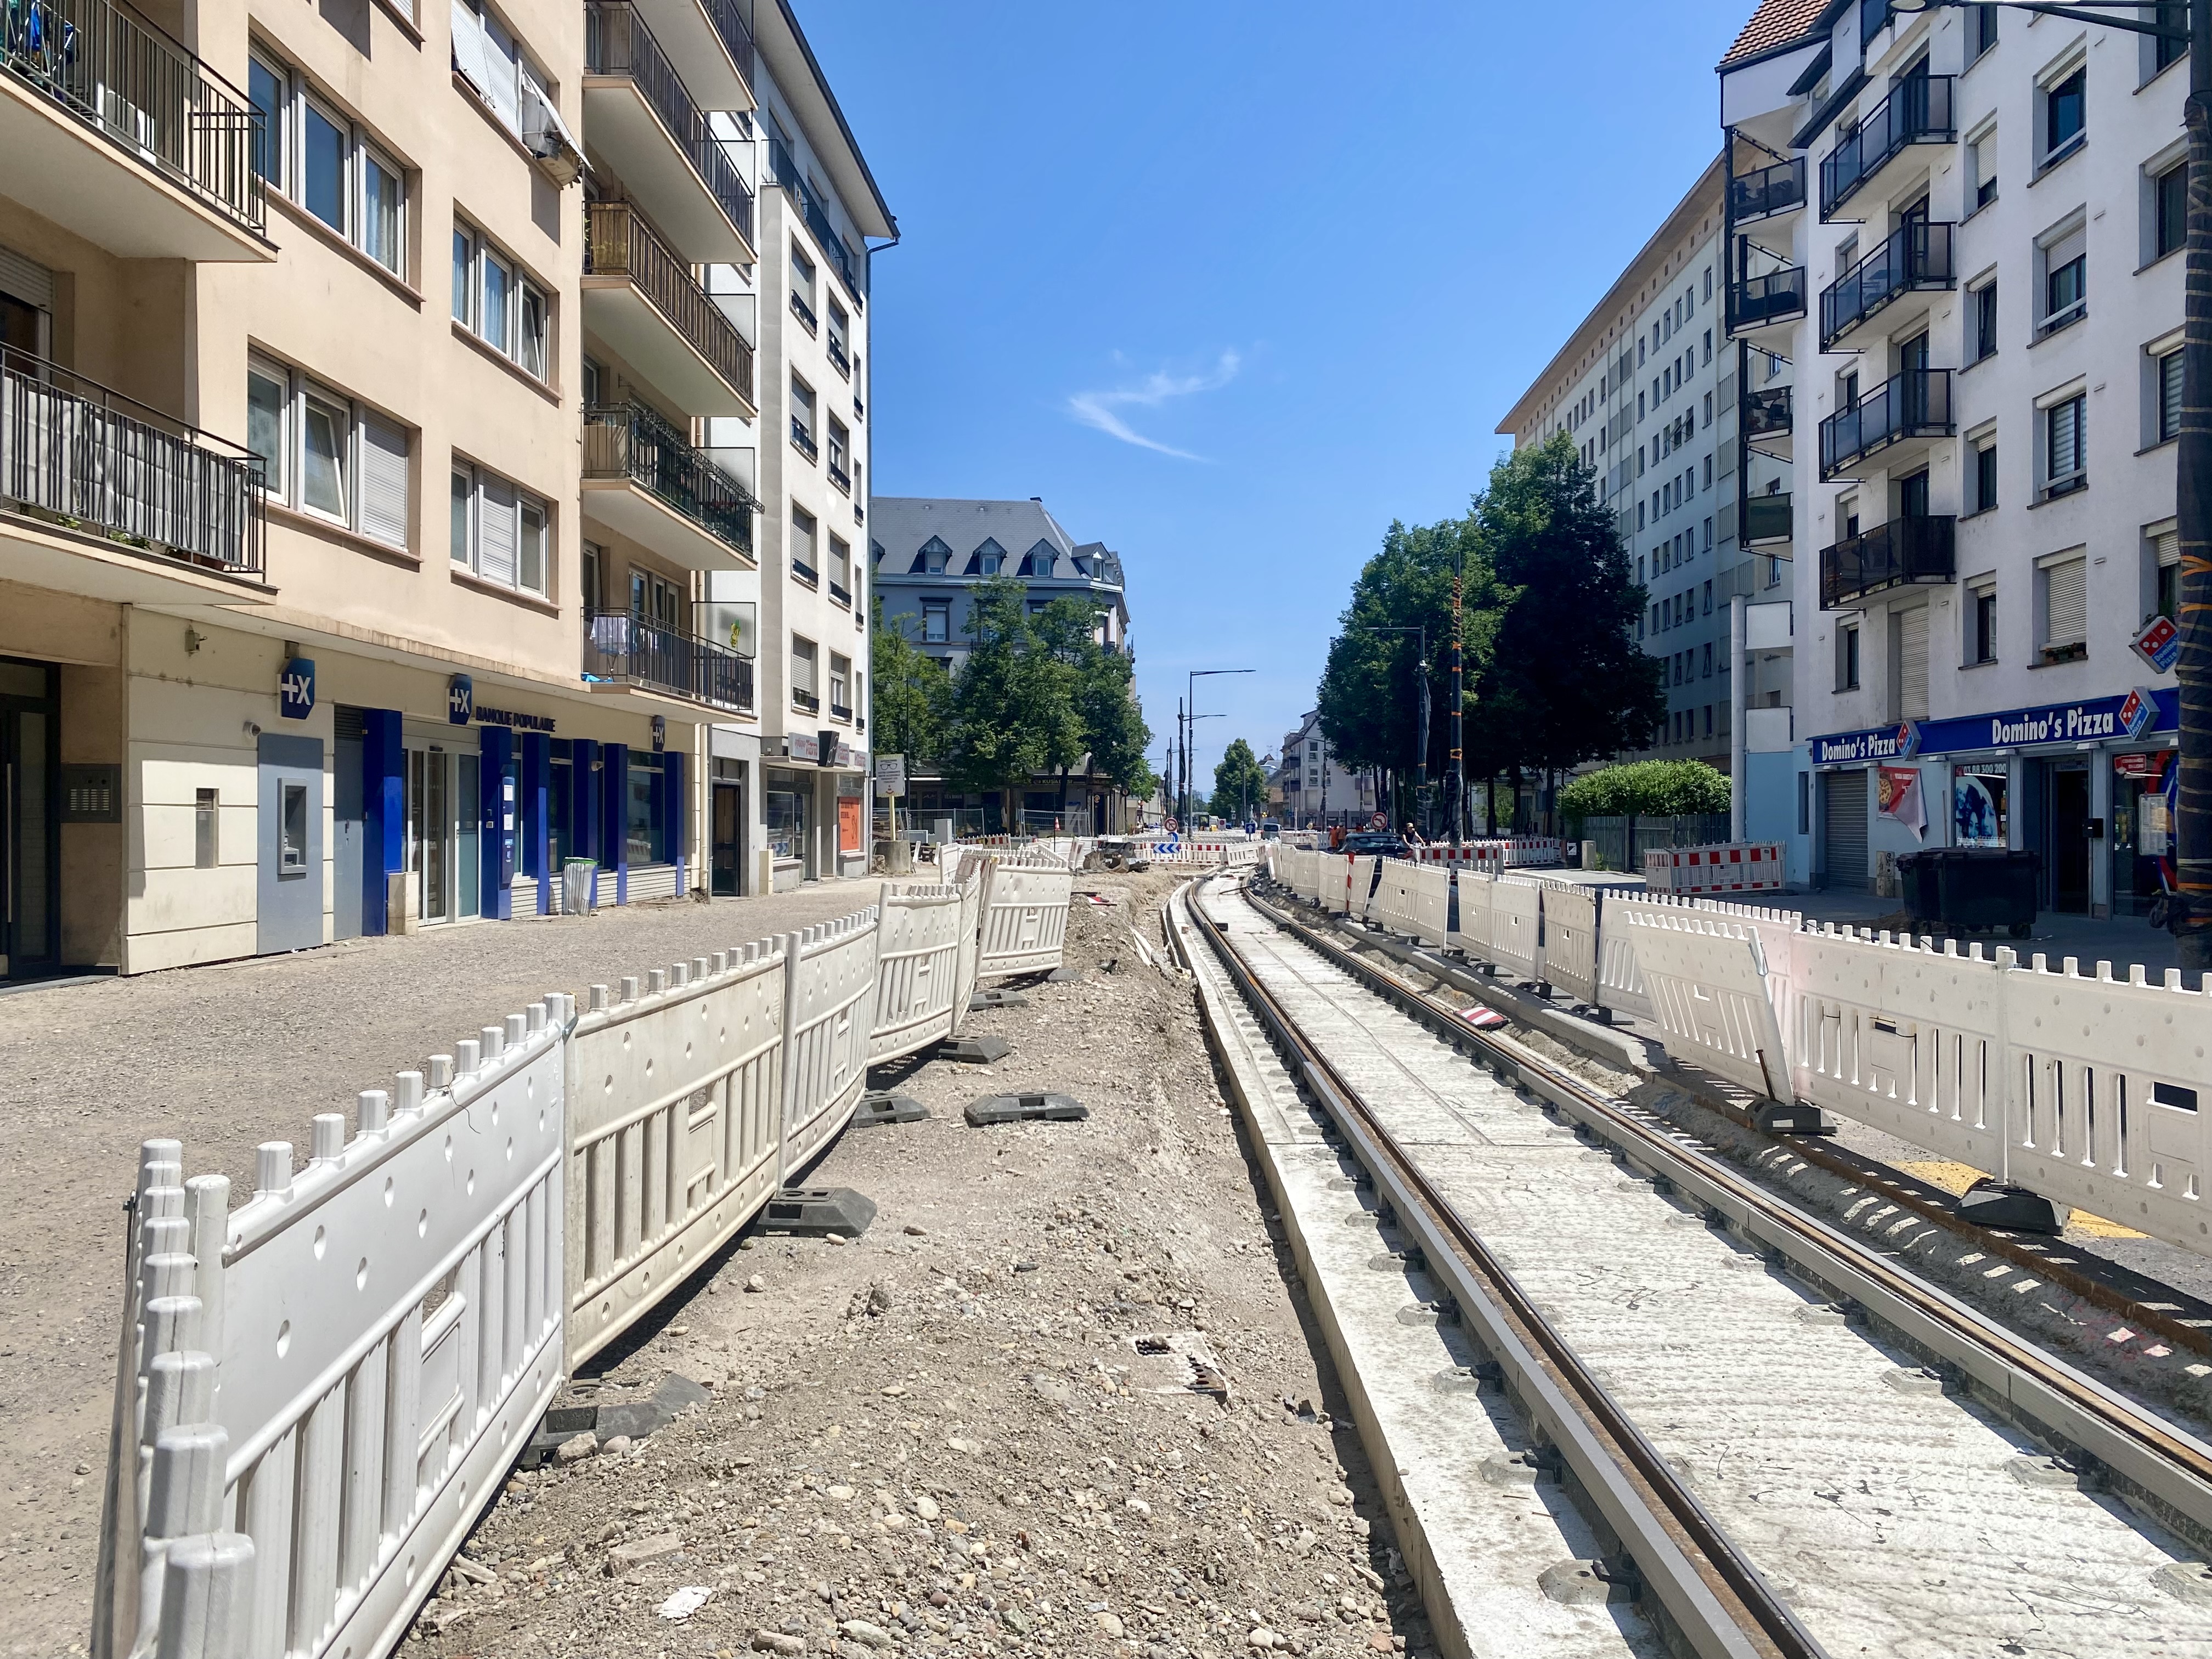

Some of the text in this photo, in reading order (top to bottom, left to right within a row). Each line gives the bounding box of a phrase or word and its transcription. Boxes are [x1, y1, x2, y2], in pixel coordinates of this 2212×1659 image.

[475, 706, 556, 732] BANQUE POPULAIRE
[1992, 706, 2114, 745] Domino's Pizza
[1821, 736, 1866, 761] Domino's
[1867, 733, 1896, 757] Pizza
[1994, 763, 2007, 774] 200
